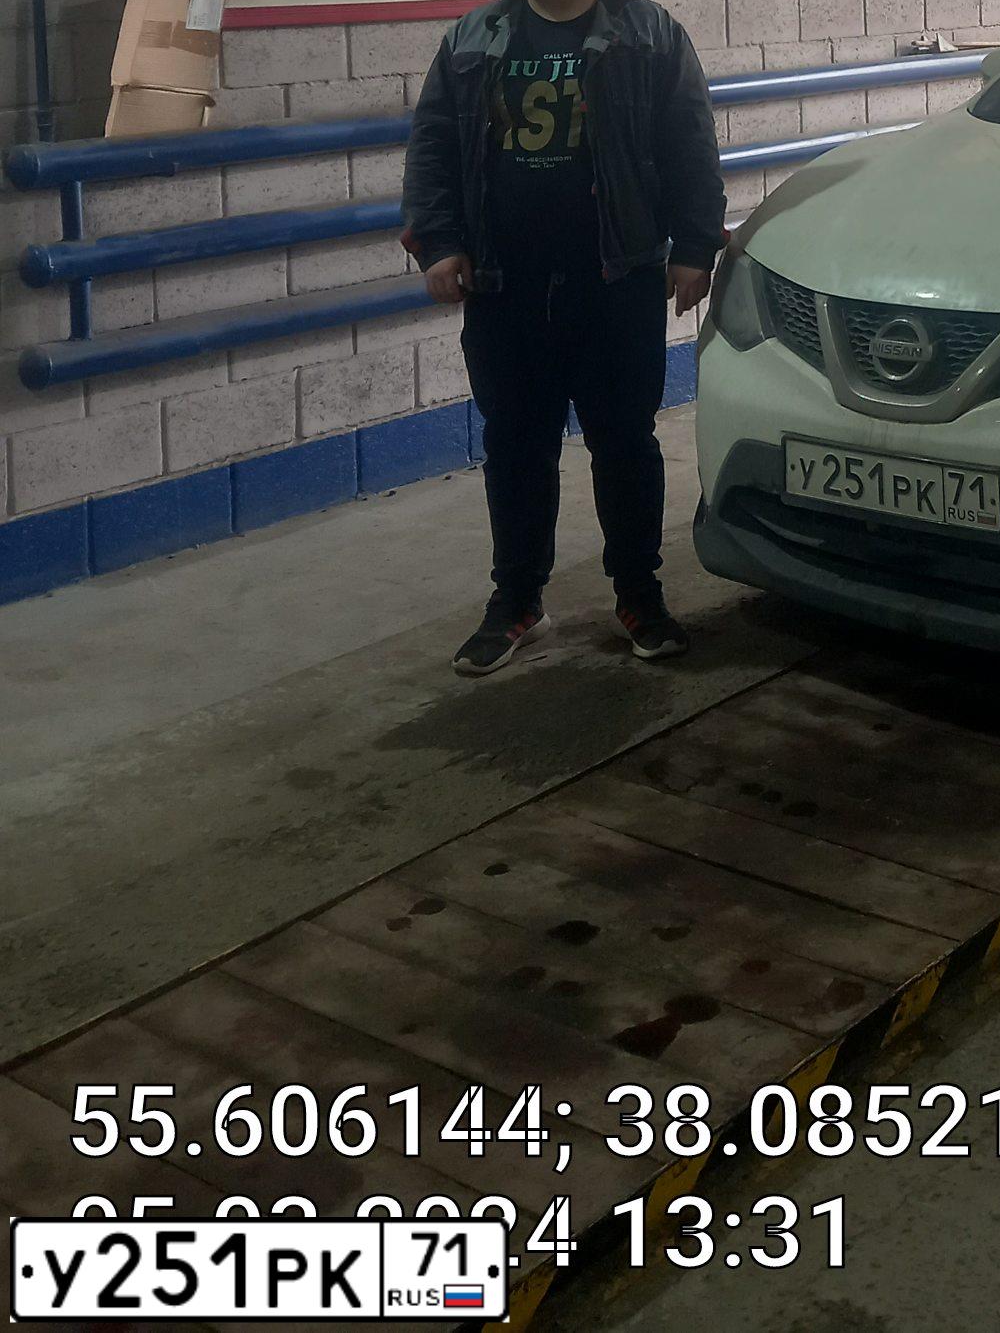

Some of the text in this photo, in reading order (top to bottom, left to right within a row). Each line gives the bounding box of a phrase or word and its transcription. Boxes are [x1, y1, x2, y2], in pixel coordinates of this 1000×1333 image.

[876, 342, 922, 357] NISSAN
[948, 471, 985, 511] 71
[948, 506, 976, 523] RUS
